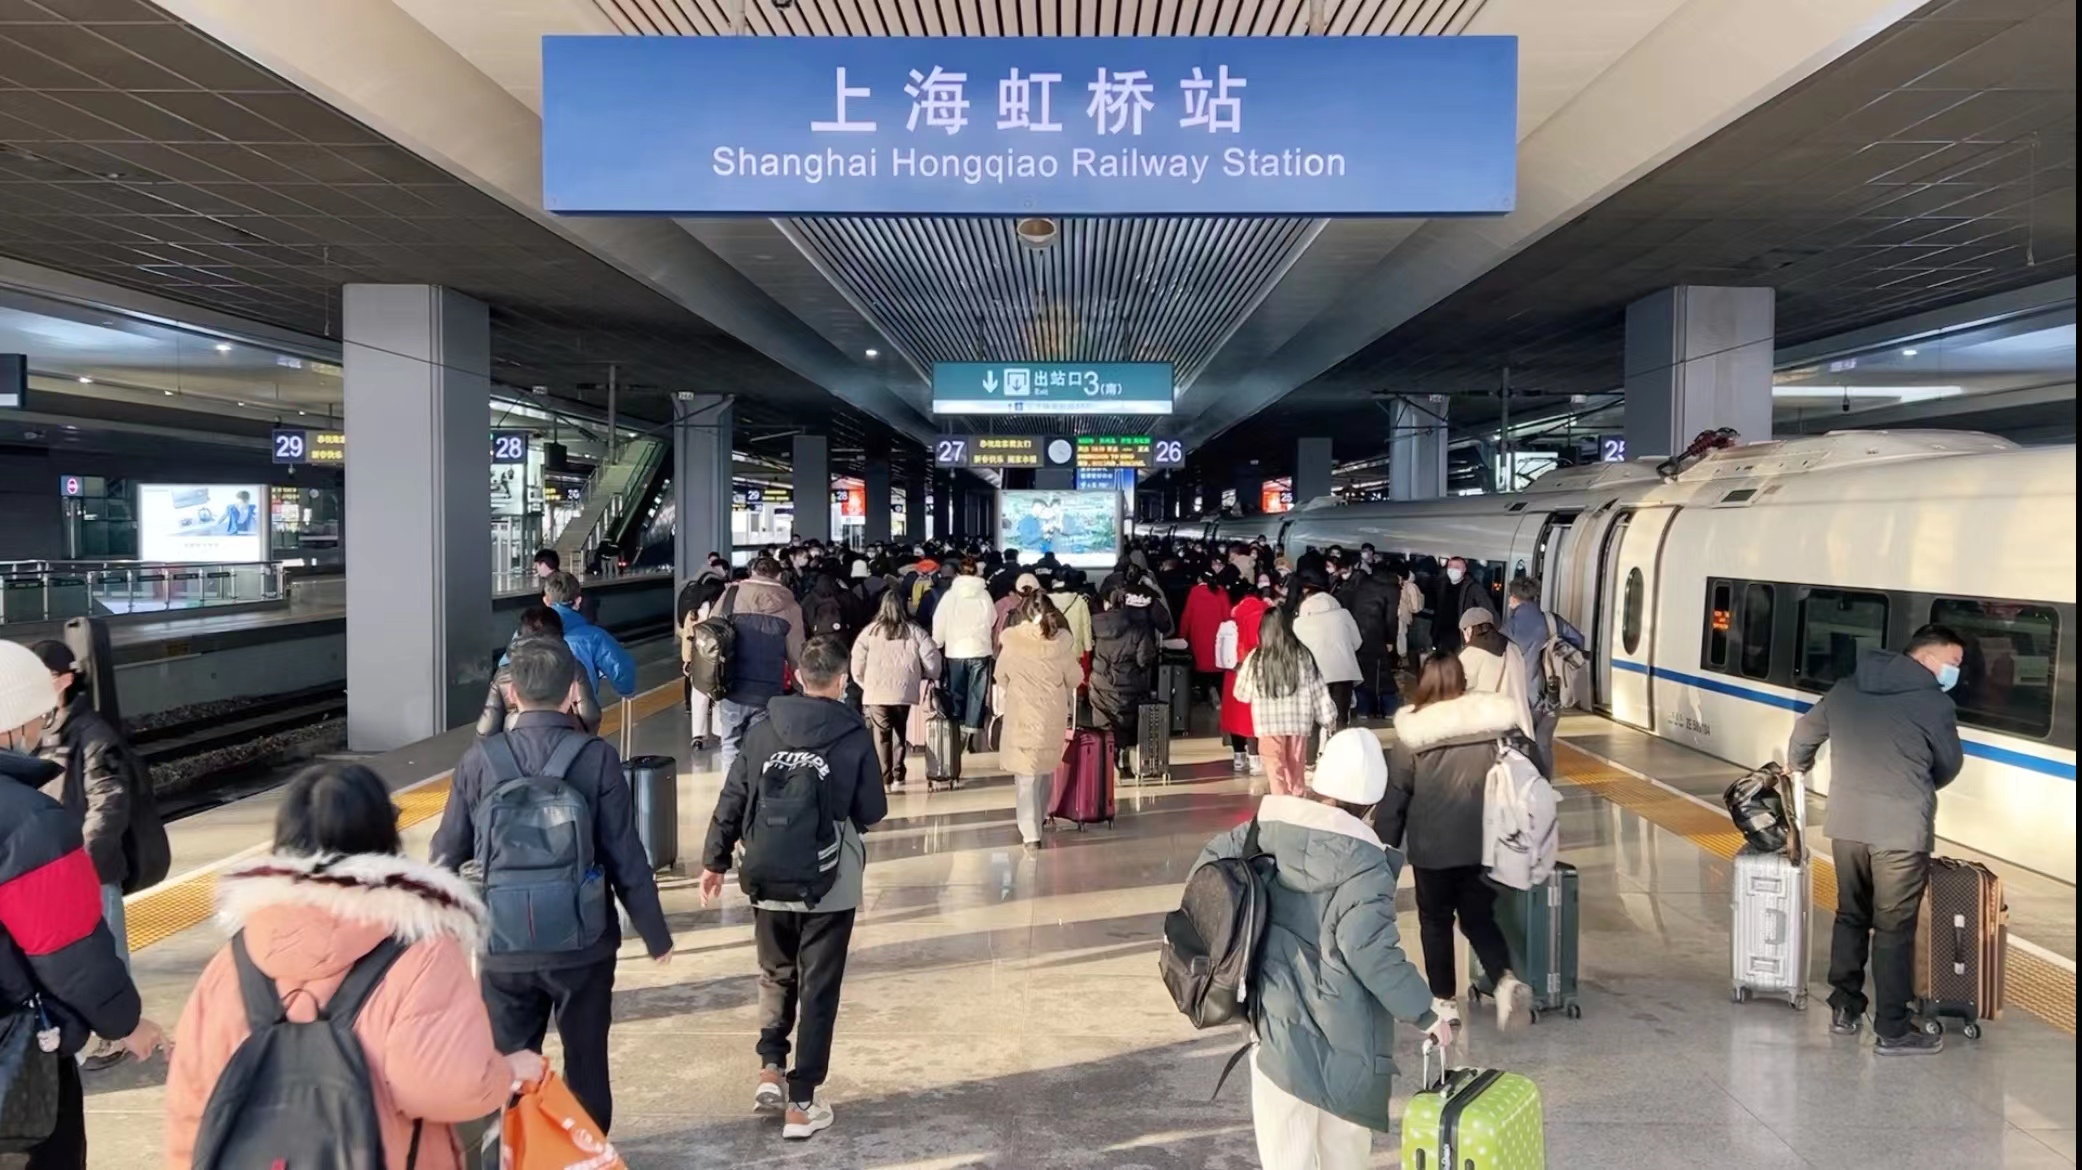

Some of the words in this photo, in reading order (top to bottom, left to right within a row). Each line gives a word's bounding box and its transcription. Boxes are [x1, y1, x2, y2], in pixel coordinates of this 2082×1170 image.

[811, 64, 1248, 135] 上海虹桥站
[713, 147, 877, 183] Shanghai
[893, 147, 1058, 184] Hongqiao
[1073, 147, 1209, 183] Railway
[1224, 147, 1345, 177] Station
[276, 435, 303, 457] 29
[495, 437, 522, 458] 28
[939, 440, 965, 462] 27
[1155, 441, 1182, 462] 26
